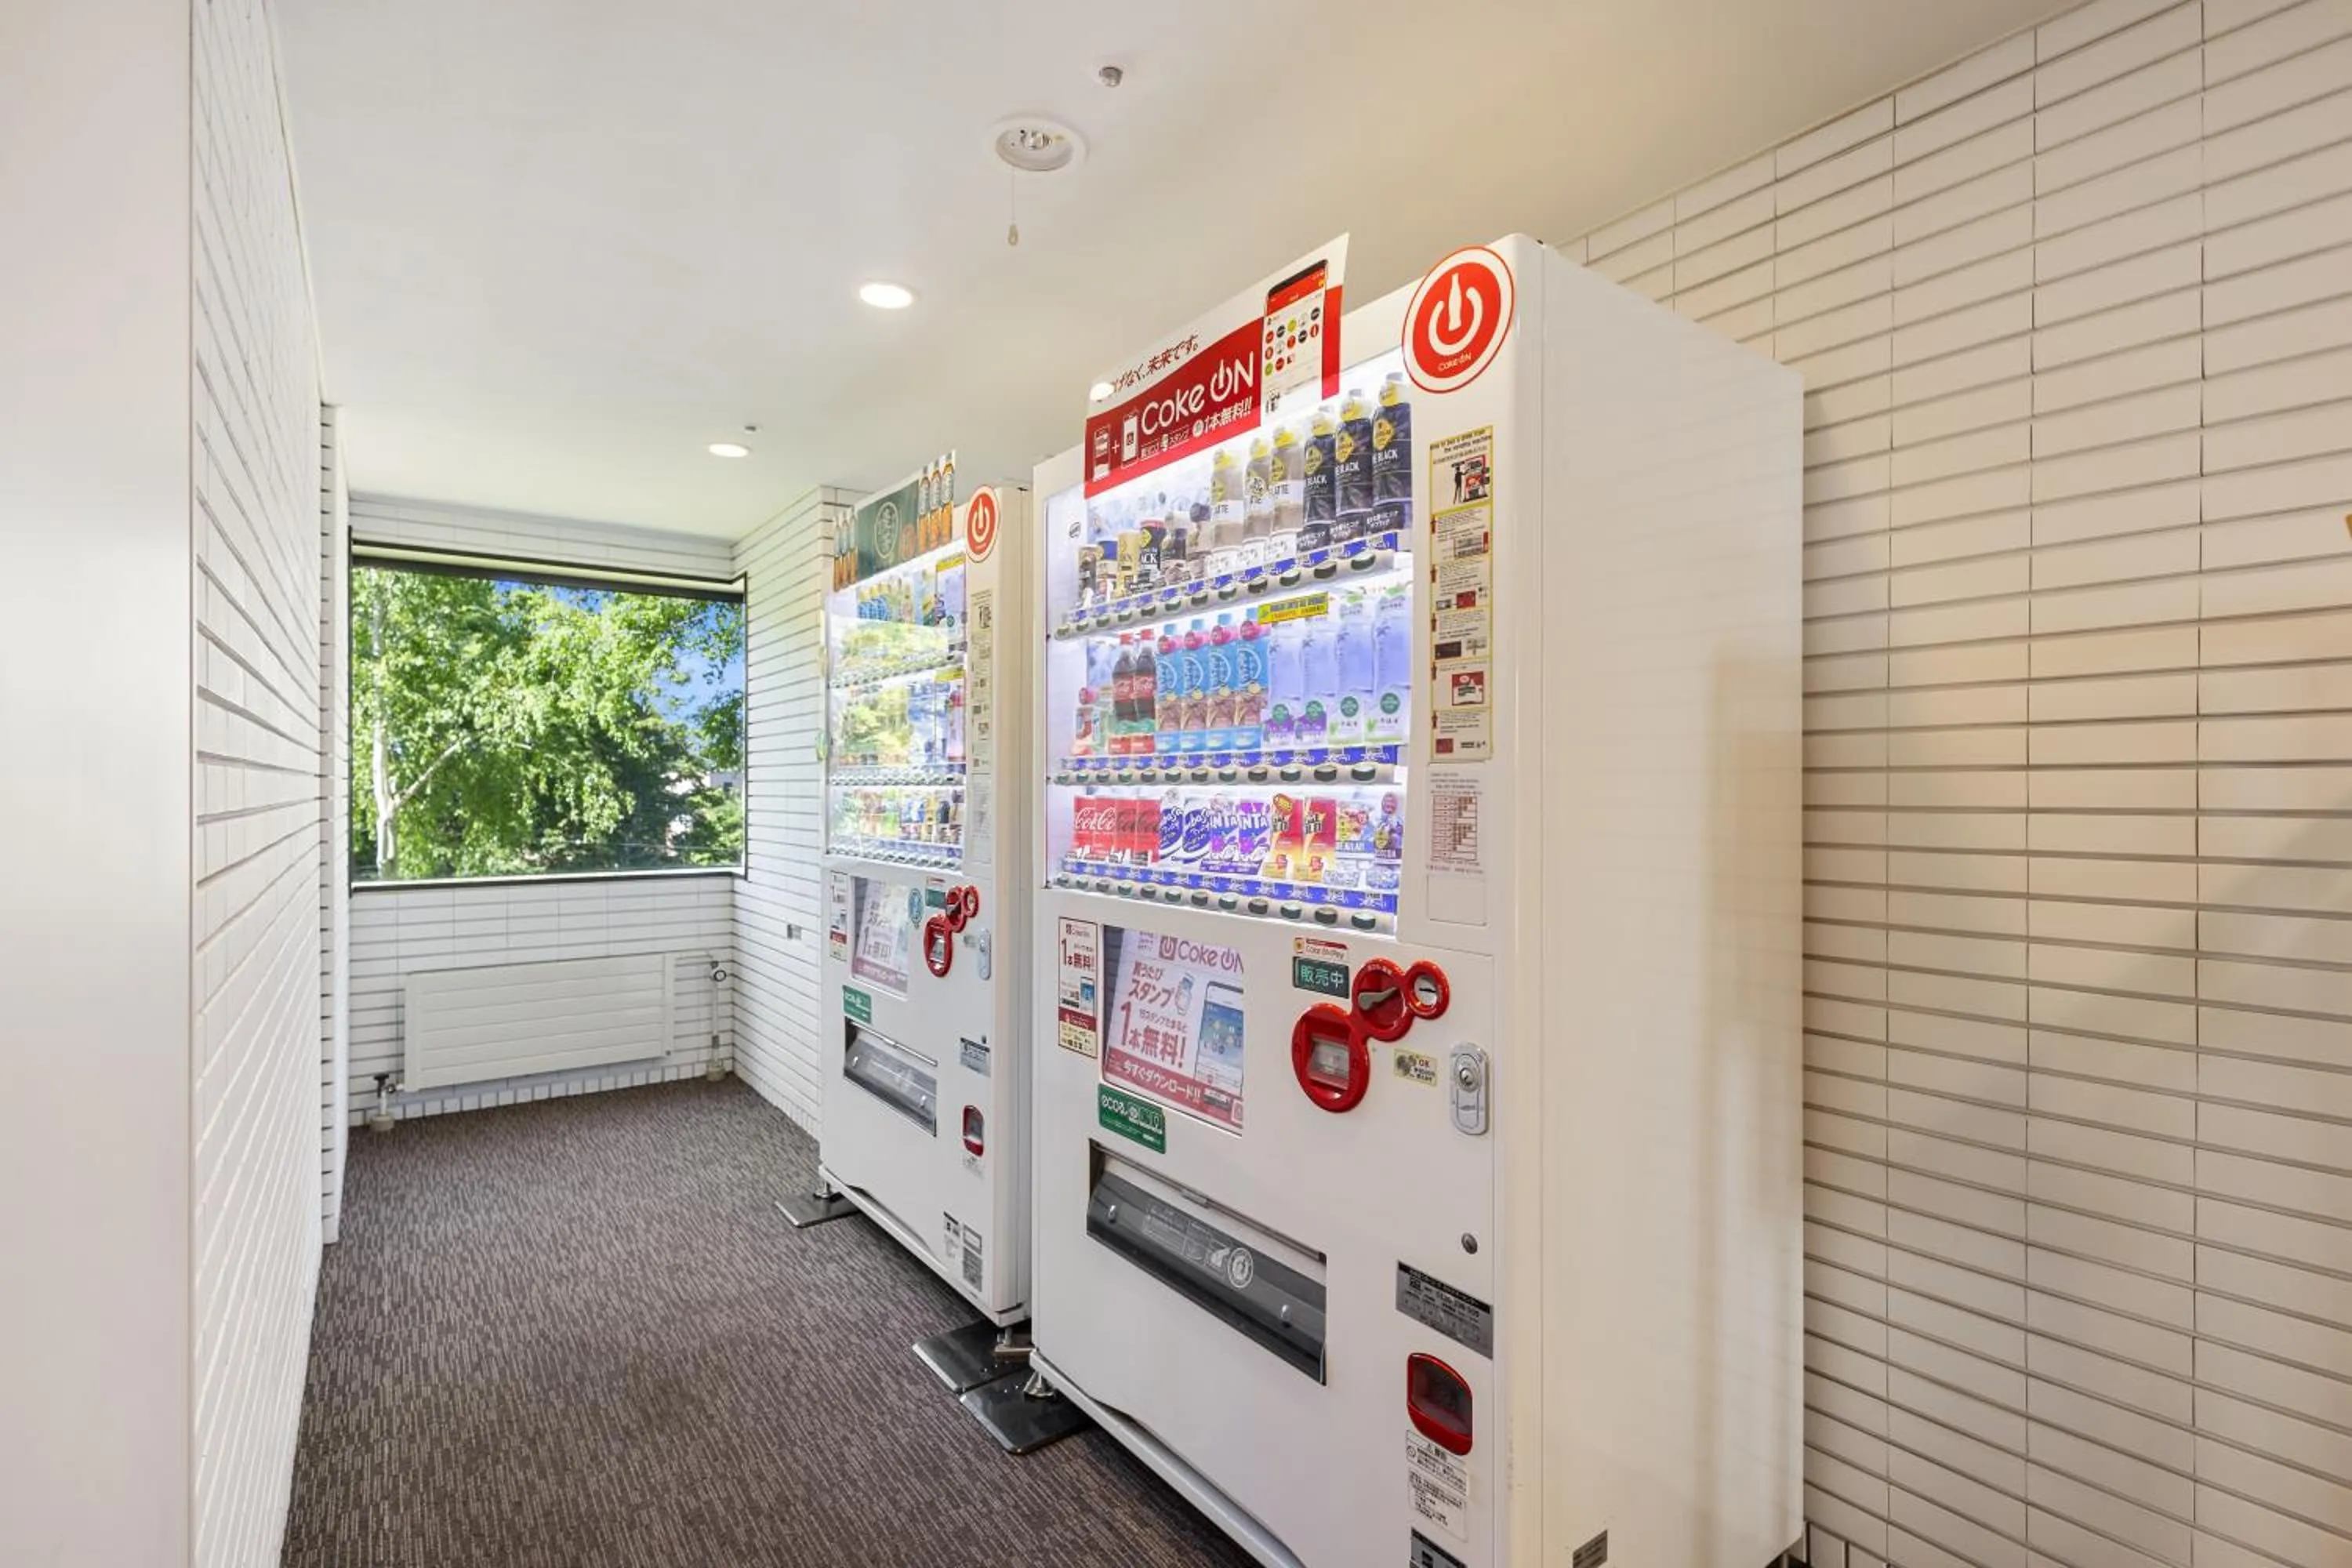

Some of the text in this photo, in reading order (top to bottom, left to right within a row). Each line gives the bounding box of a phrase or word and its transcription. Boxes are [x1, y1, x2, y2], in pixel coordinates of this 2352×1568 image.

[1141, 383, 1205, 435] Coke
[1210, 811, 1239, 829] NTA
[1238, 812, 1269, 831] NTA
[1178, 940, 1218, 967] Coke
[1300, 965, 1345, 989] 販売中
[1128, 978, 1174, 1008] スタンプ
[1120, 1000, 1186, 1069] 1本無料!
